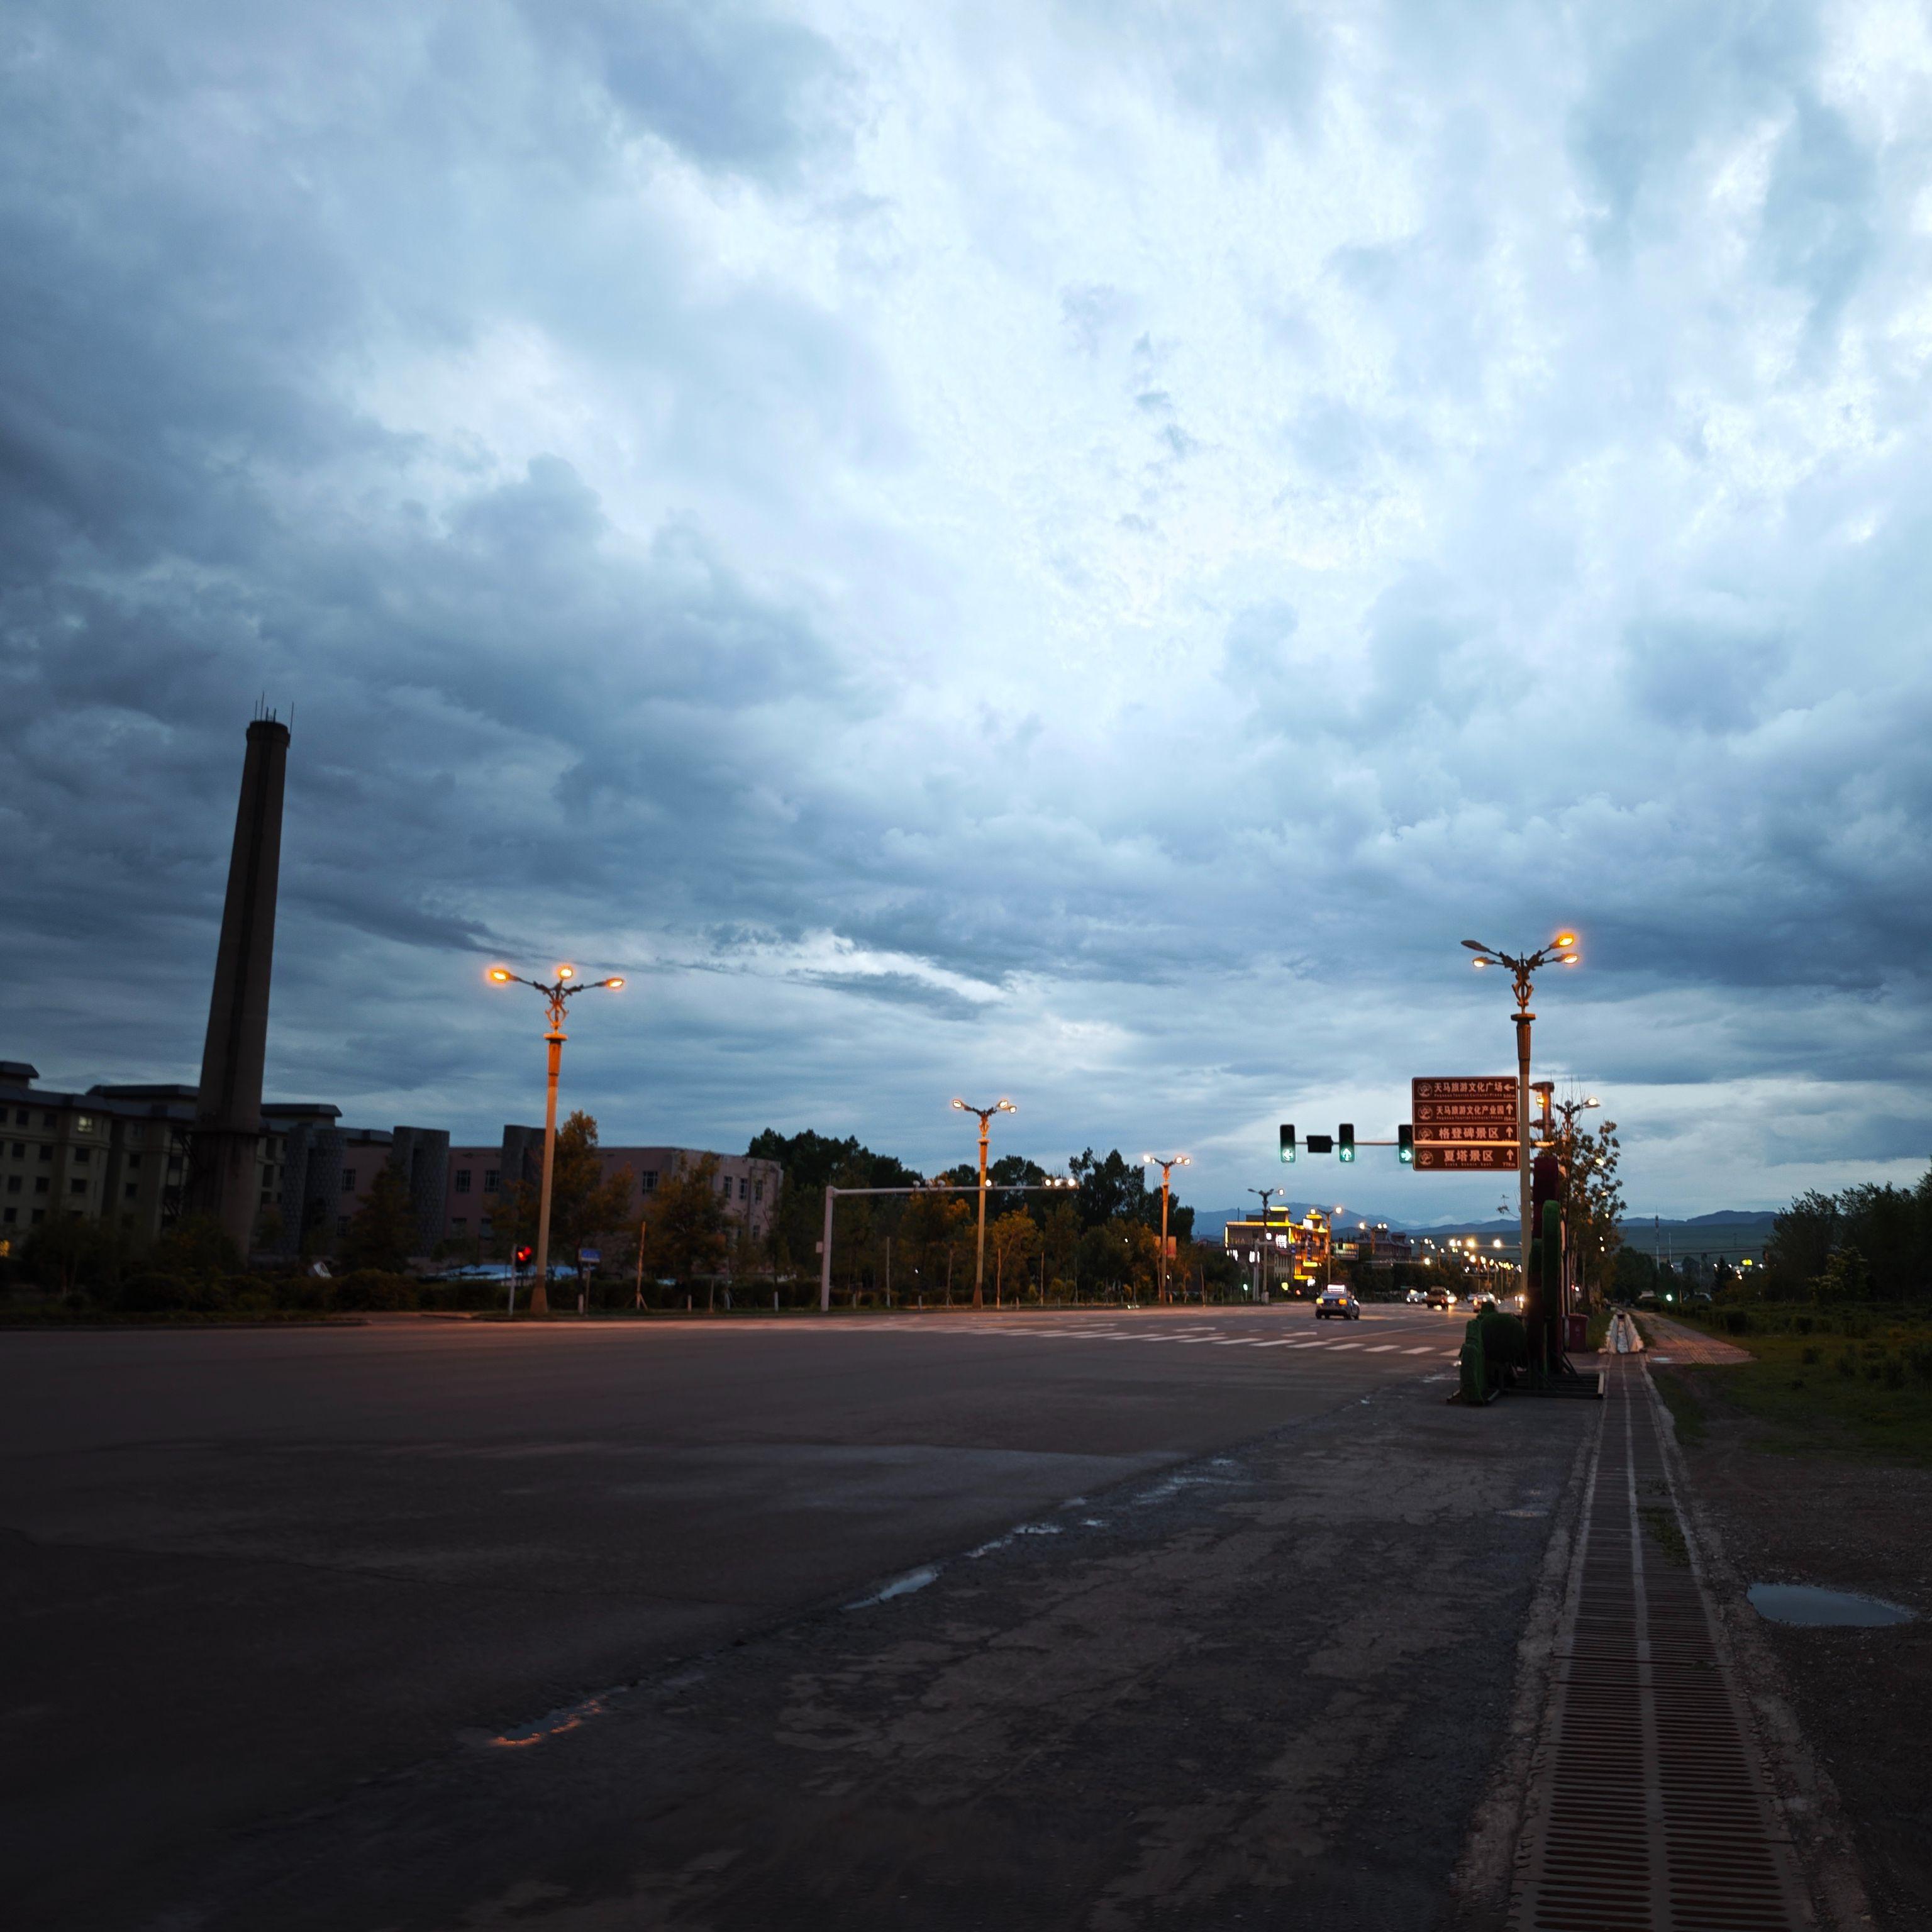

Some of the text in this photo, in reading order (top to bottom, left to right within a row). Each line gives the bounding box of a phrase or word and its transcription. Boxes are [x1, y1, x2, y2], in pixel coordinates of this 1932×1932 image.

[1434, 1082, 1502, 1092] 天马旅游文化广场
[1436, 1105, 1504, 1115] 天马旅游文化产业园
[1439, 1127, 1499, 1140] 格登碑景区
[1443, 1149, 1494, 1162] 夏塔景区
